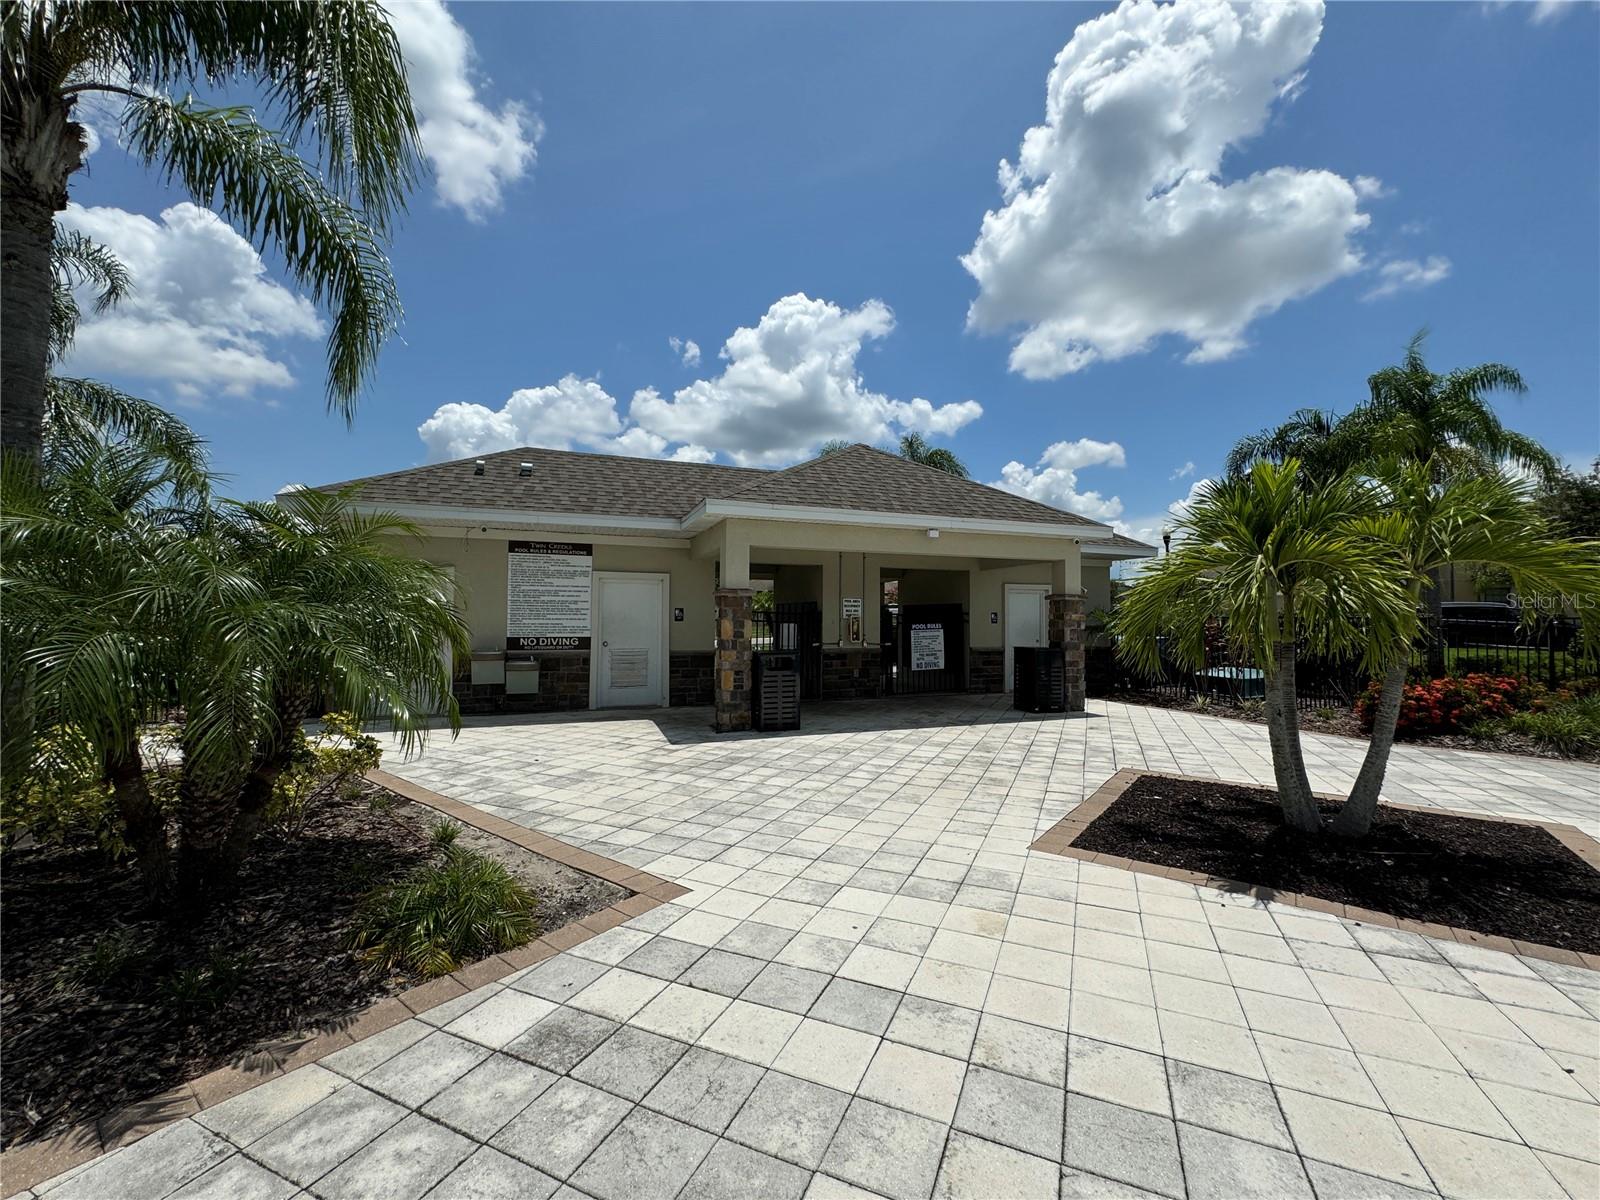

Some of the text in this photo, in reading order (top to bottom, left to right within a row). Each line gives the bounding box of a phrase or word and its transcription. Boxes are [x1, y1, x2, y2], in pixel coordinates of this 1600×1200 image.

[519, 637, 579, 646] NO DIVING
[916, 660, 941, 669] NO DIVING
